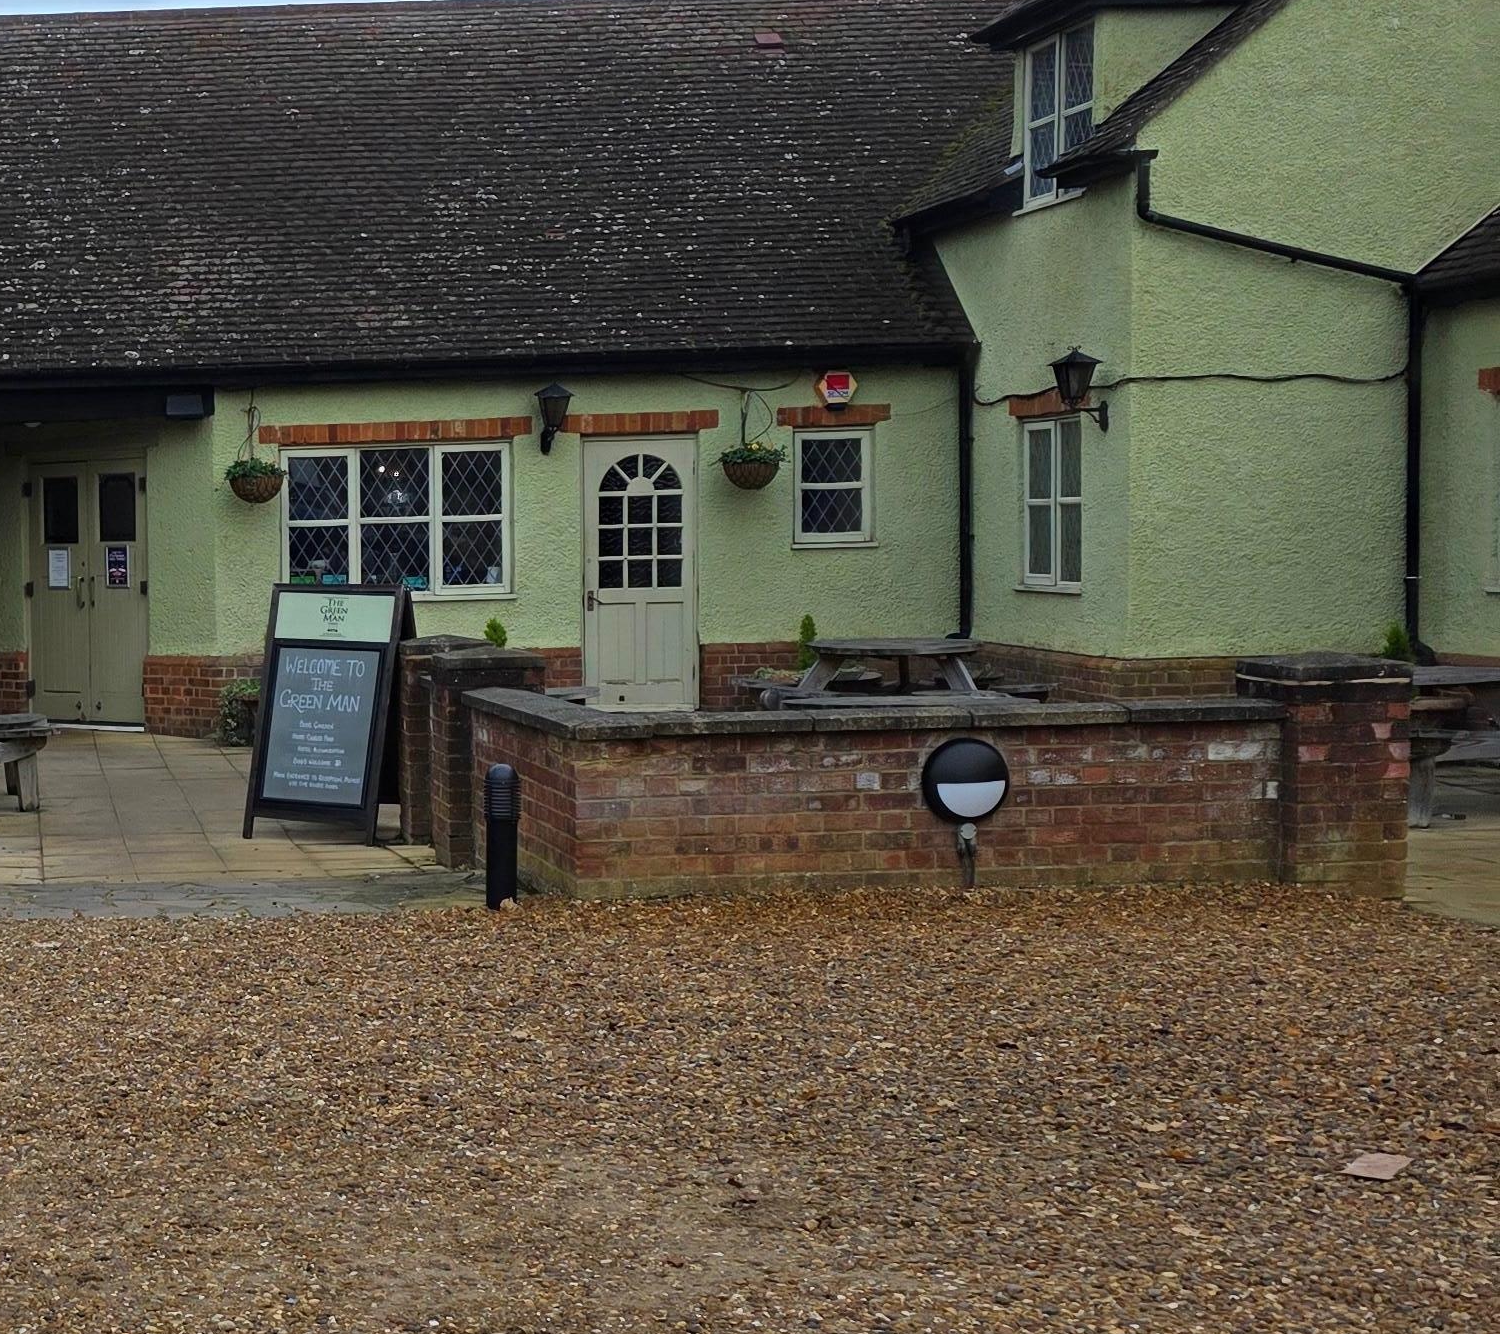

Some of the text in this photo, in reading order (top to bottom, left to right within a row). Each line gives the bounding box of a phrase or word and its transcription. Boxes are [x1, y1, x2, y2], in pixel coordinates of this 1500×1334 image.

[320, 605, 349, 616] GREEN
[323, 613, 345, 623] MAN
[285, 655, 366, 679] WELCOME TO
[311, 677, 334, 692] THE
[280, 689, 361, 714] GREEN MAN
